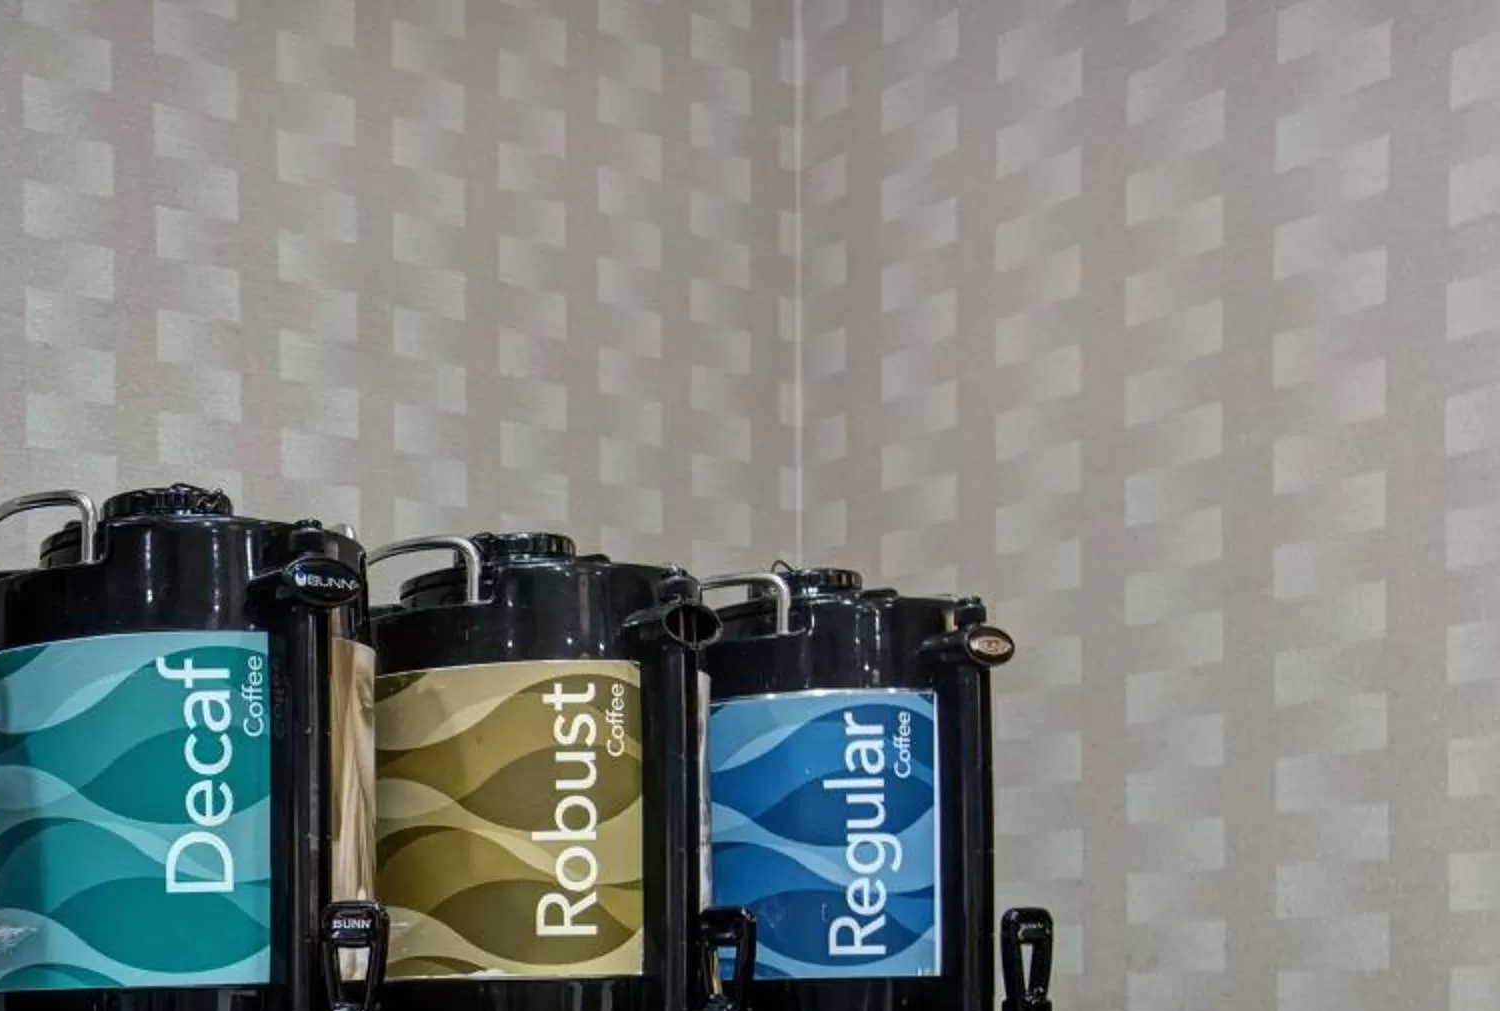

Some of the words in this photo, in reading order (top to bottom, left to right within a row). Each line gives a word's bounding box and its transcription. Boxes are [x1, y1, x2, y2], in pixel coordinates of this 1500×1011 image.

[308, 573, 356, 591] BUNN
[242, 654, 264, 738] Coffee
[606, 682, 626, 758] Coffee
[156, 656, 235, 894] Decaf
[893, 710, 912, 779] Coffee
[530, 682, 598, 937] Robust
[823, 711, 903, 956] Regular
[332, 919, 372, 929] BUNN
